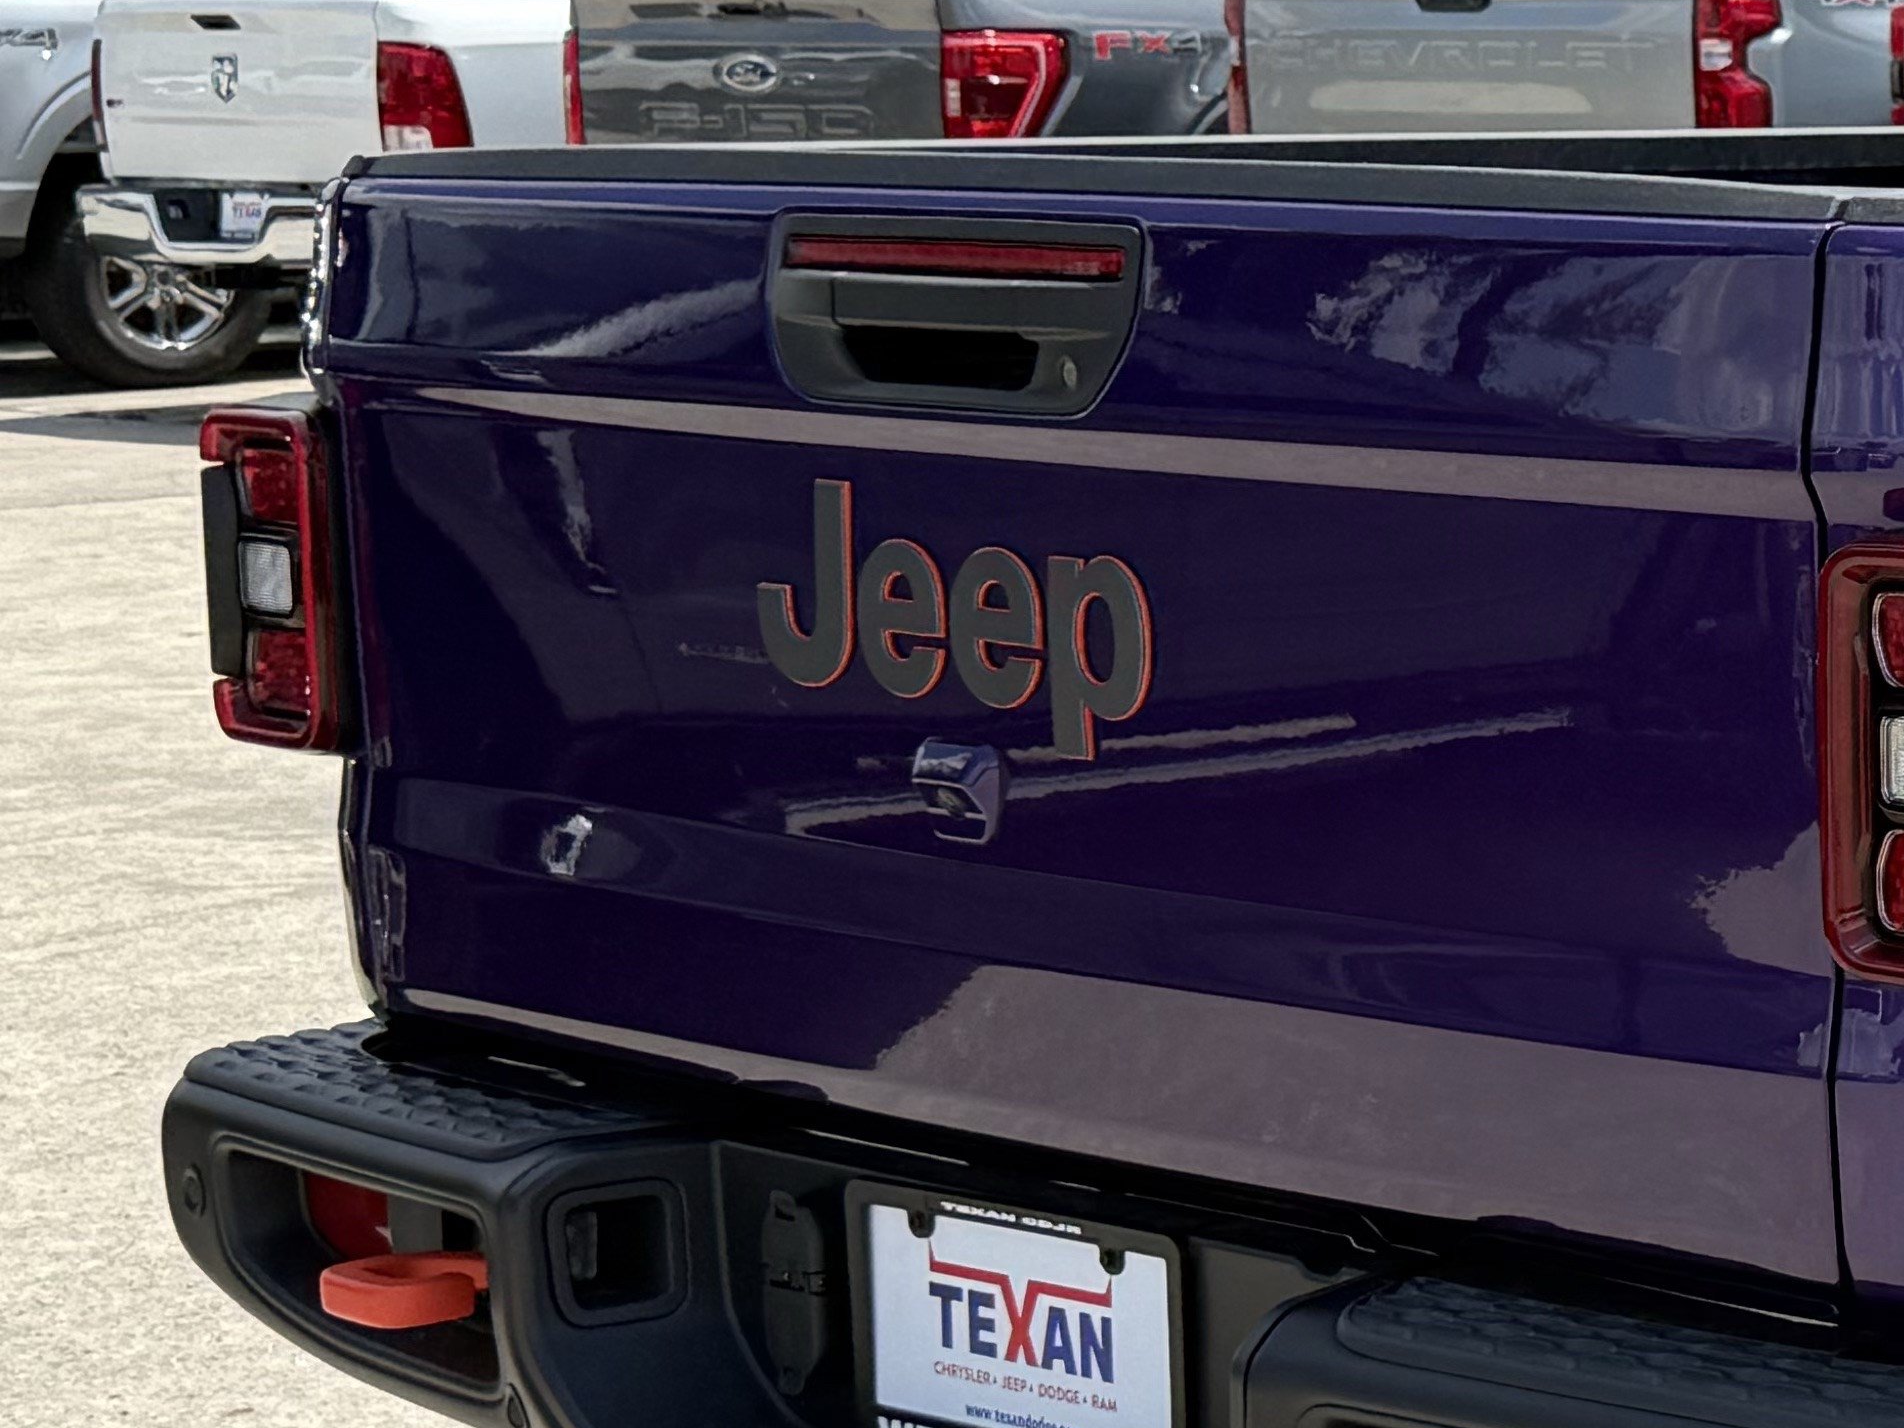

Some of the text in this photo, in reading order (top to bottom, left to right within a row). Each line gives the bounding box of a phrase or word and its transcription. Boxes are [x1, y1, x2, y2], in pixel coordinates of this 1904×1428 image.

[1092, 29, 1202, 61] FX4
[757, 478, 1152, 761] Jeep
[929, 1254, 1114, 1384] TEXAN
[934, 1360, 1117, 1412] CHRYSLER JEEP DODGE RAM
